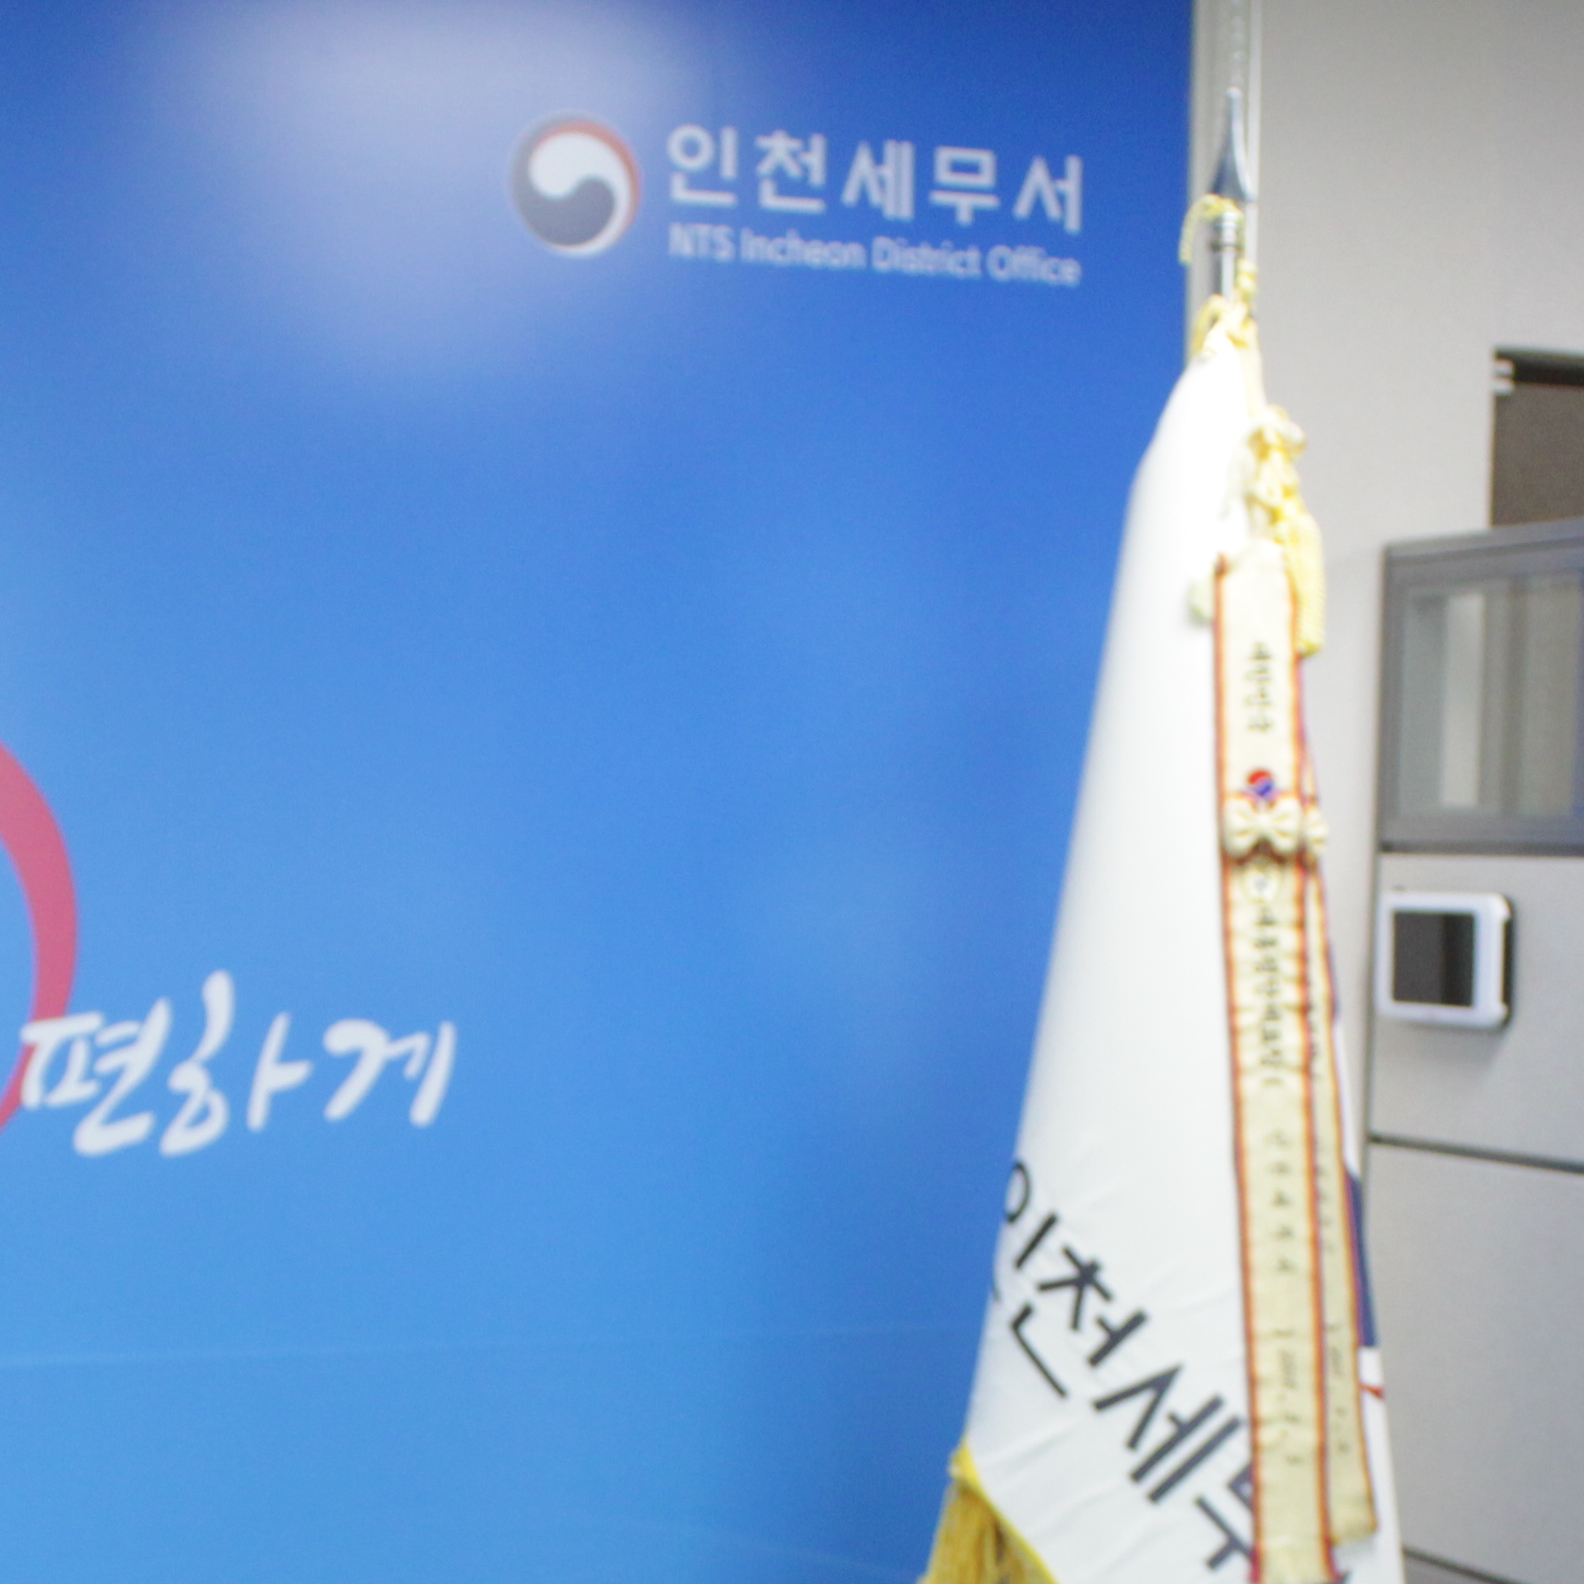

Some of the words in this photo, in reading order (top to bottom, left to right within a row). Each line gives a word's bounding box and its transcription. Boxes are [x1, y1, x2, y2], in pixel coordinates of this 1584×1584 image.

[666, 123, 1084, 234] 인천세무서
[668, 222, 736, 262] NTS
[740, 227, 867, 271] Incheon
[872, 235, 984, 280] District
[987, 243, 1084, 288] Office
[19, 968, 458, 1157] 편하게
